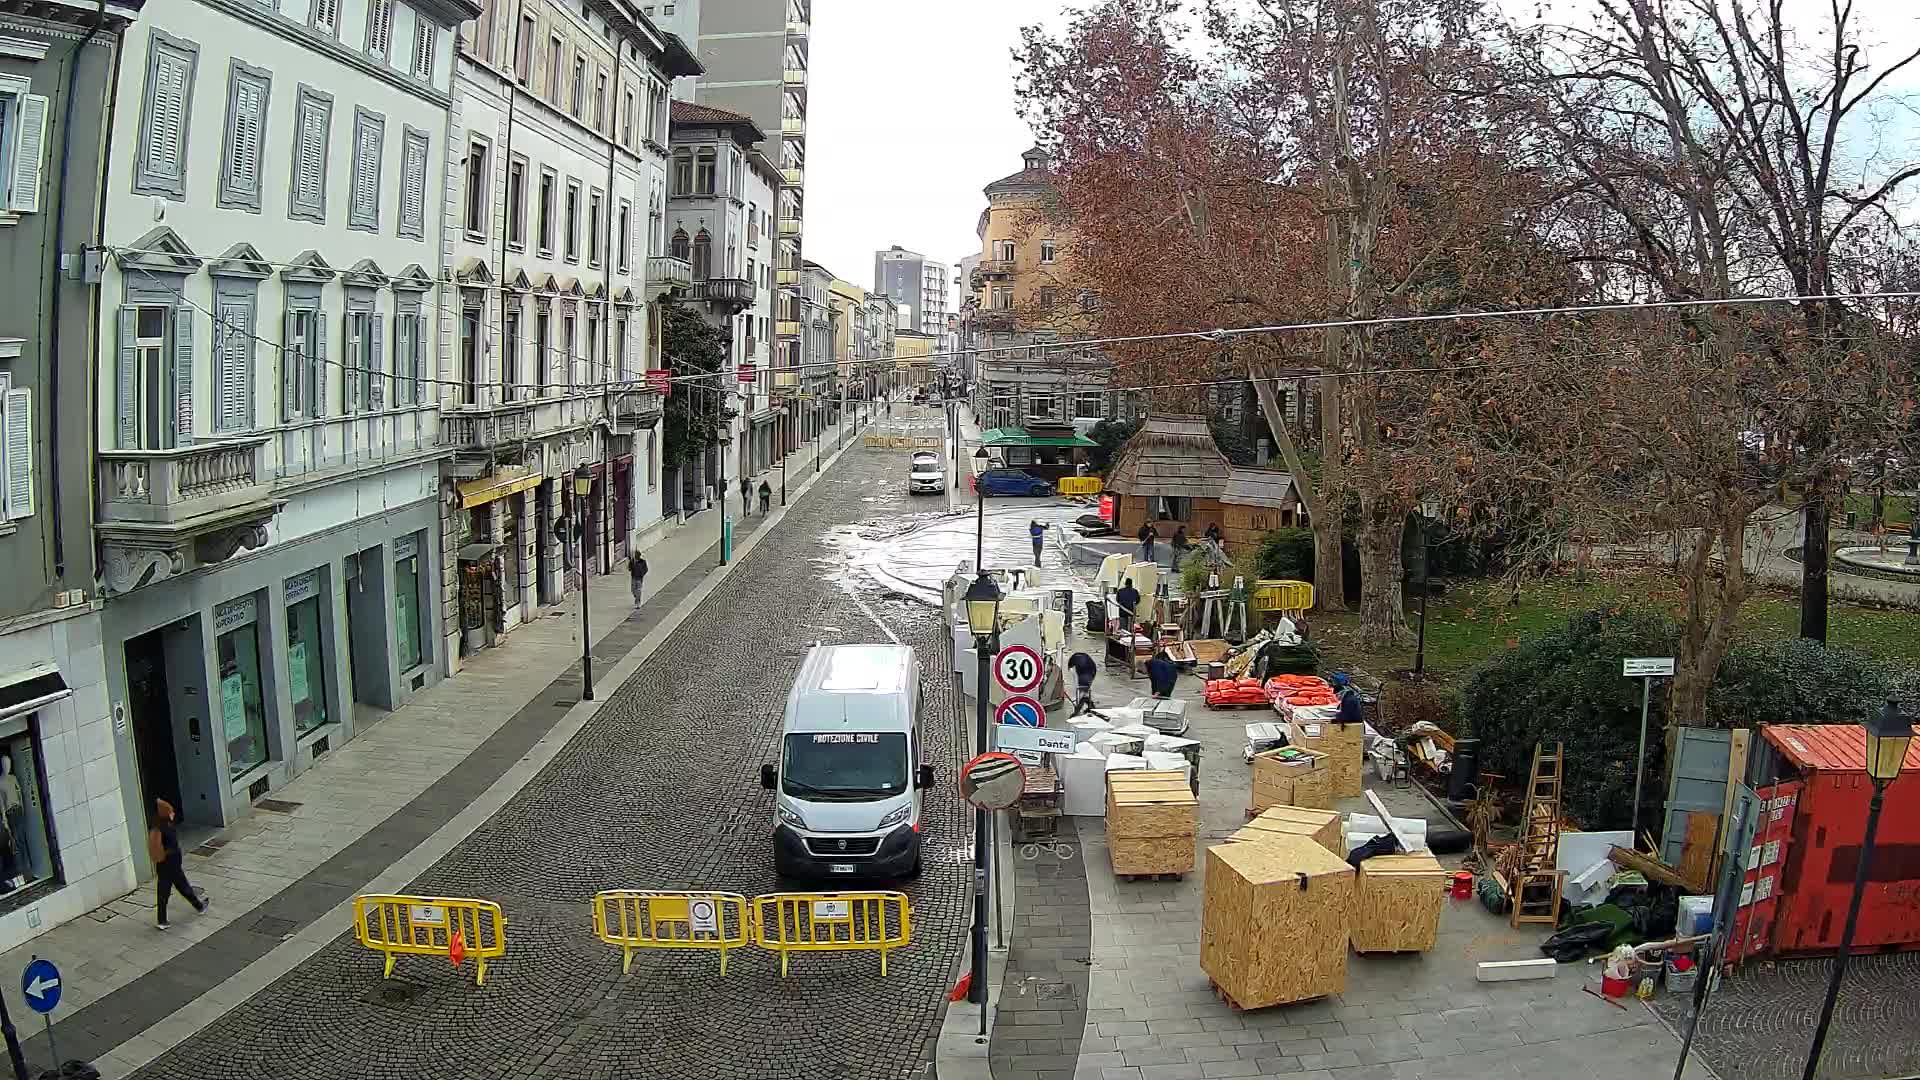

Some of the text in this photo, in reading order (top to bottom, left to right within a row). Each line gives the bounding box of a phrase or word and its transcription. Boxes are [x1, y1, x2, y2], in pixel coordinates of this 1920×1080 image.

[1005, 658, 1033, 681] 30
[813, 734, 880, 743] PROTEZIONE CIVILE
[1038, 738, 1070, 749] Dante
